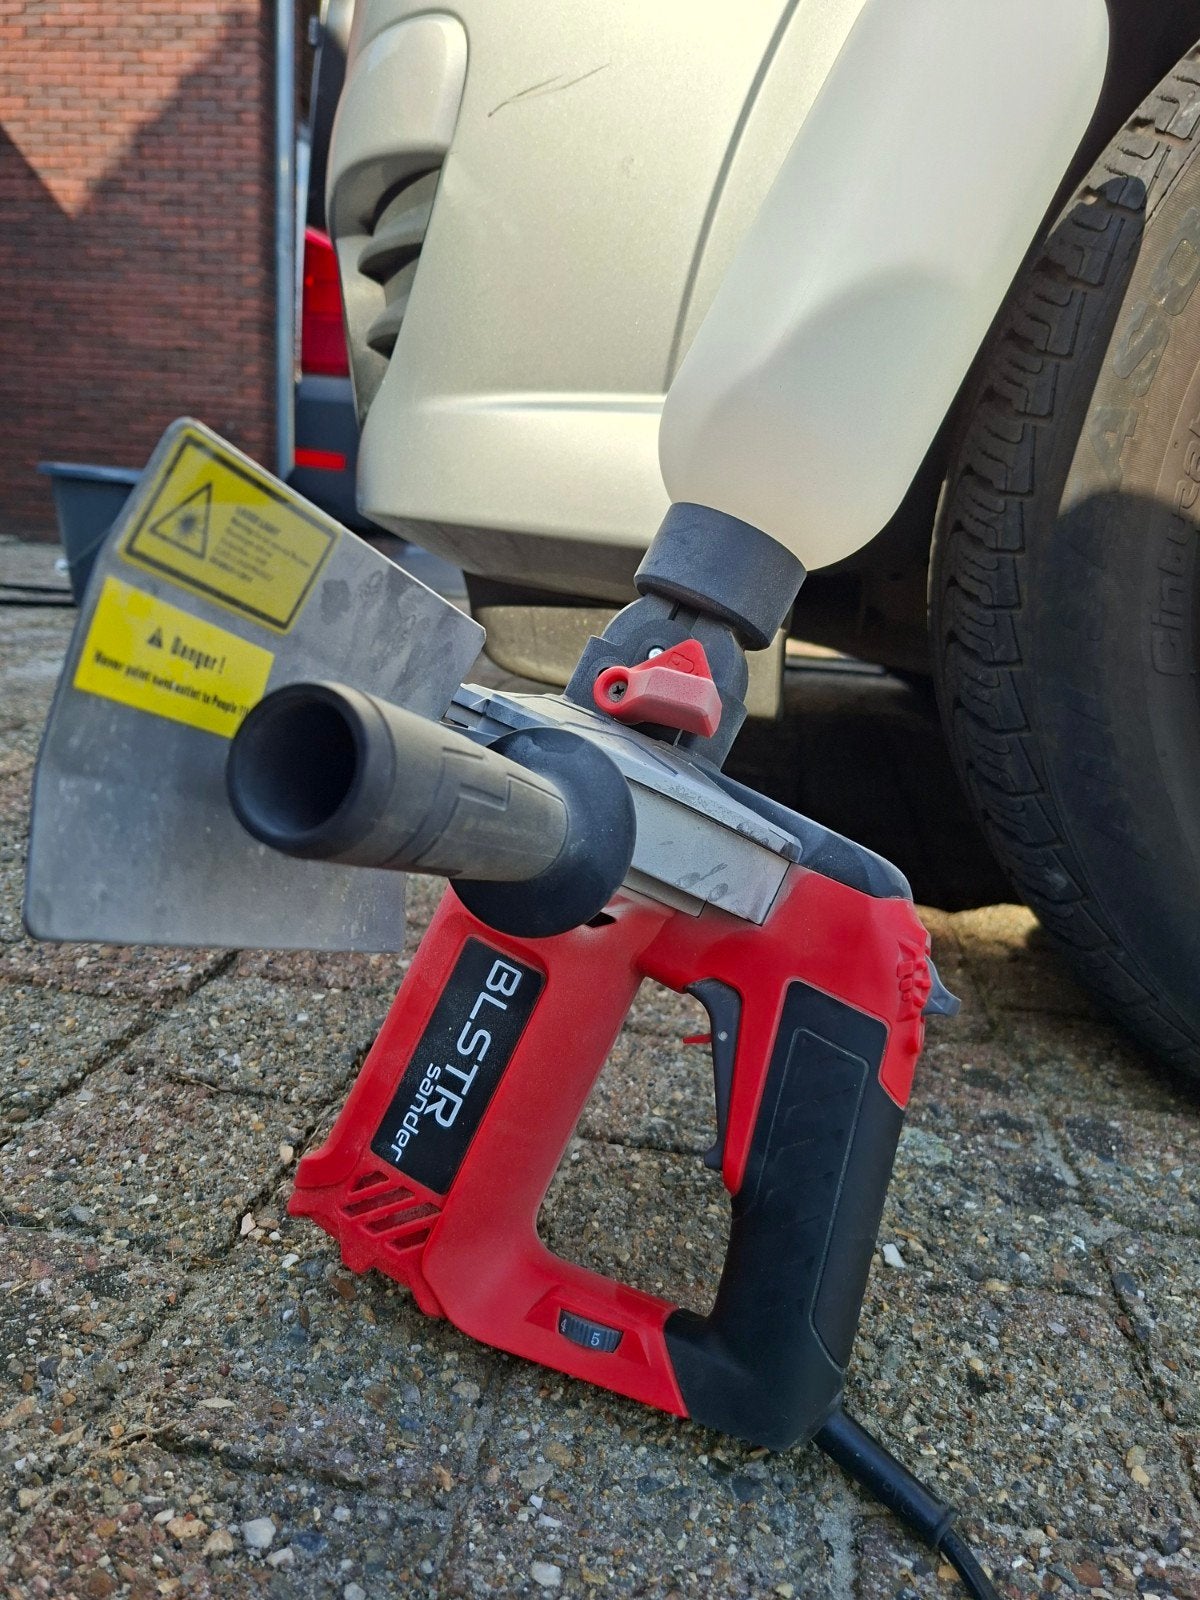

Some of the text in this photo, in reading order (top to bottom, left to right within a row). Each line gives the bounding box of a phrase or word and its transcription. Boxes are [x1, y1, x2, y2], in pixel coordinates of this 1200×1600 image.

[424, 959, 522, 1128] BLSTR
[390, 1063, 440, 1162] sander
[590, 1332, 600, 1346] 5
